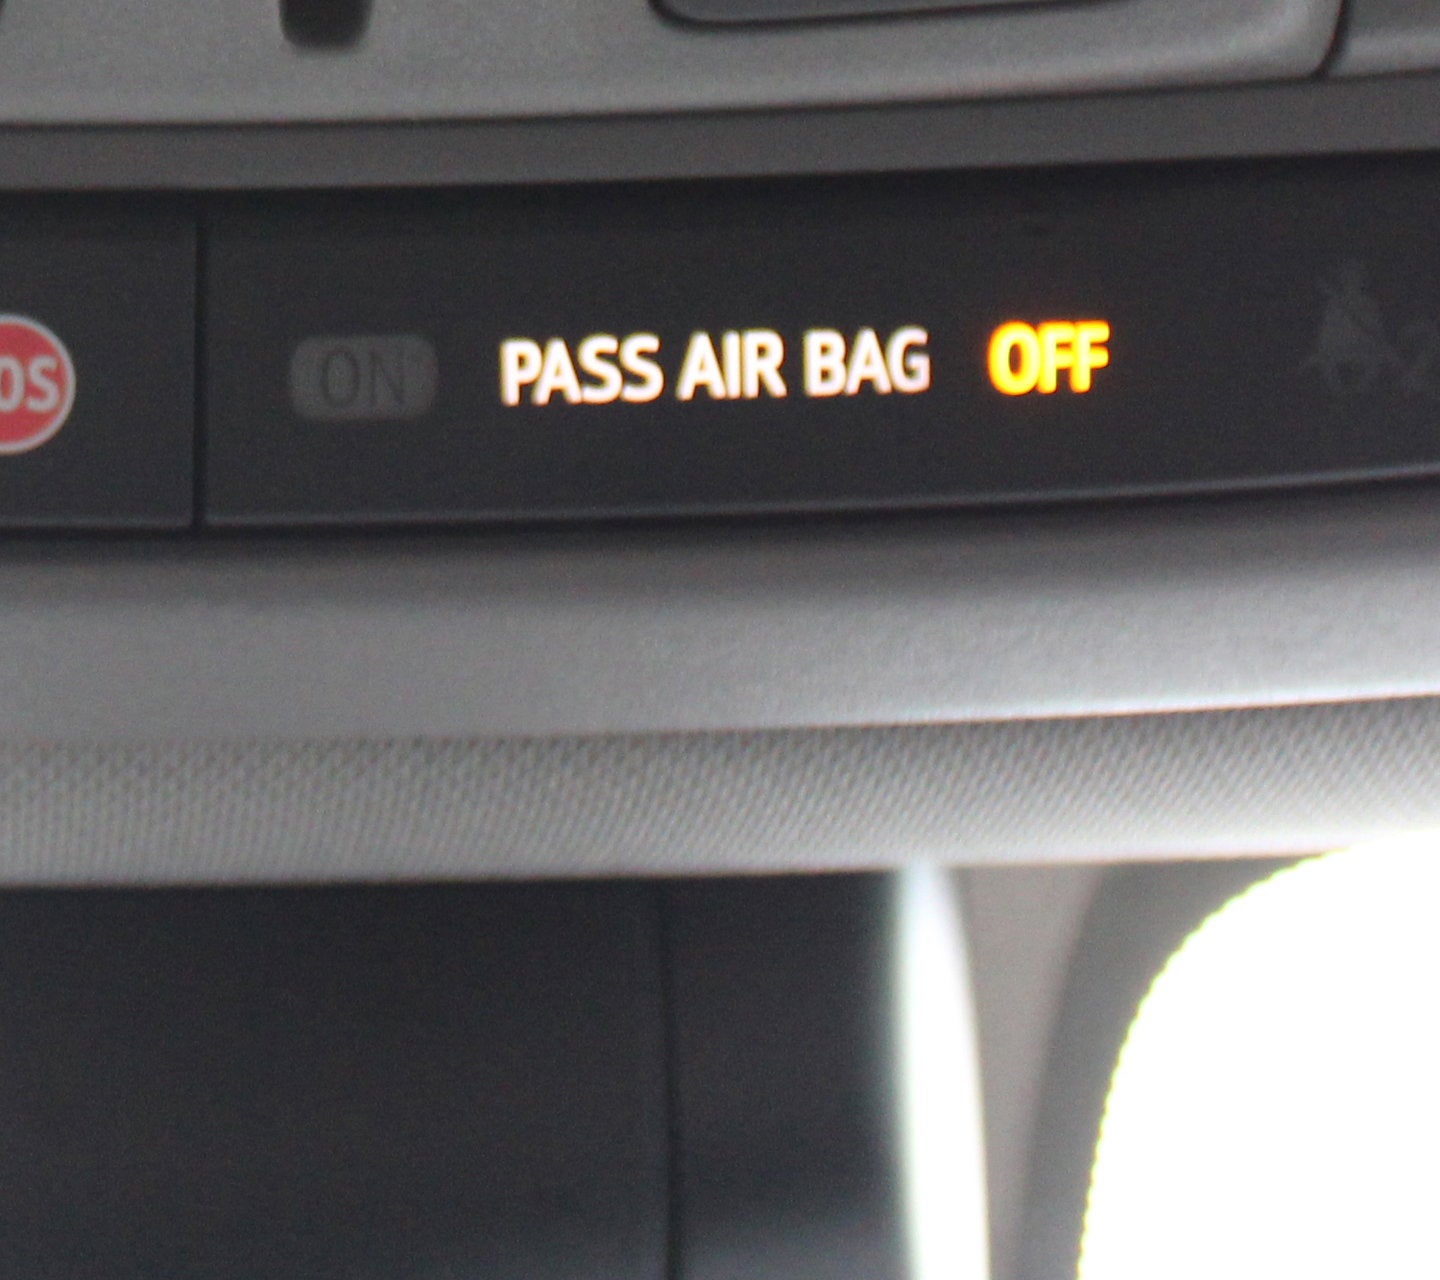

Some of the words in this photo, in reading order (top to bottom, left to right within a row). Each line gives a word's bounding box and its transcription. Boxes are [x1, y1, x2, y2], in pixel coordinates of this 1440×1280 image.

[319, 347, 410, 409] ON
[499, 333, 665, 406] PASS
[676, 328, 788, 400] AIR
[802, 325, 931, 396] BAG
[986, 320, 1111, 395] OFF
